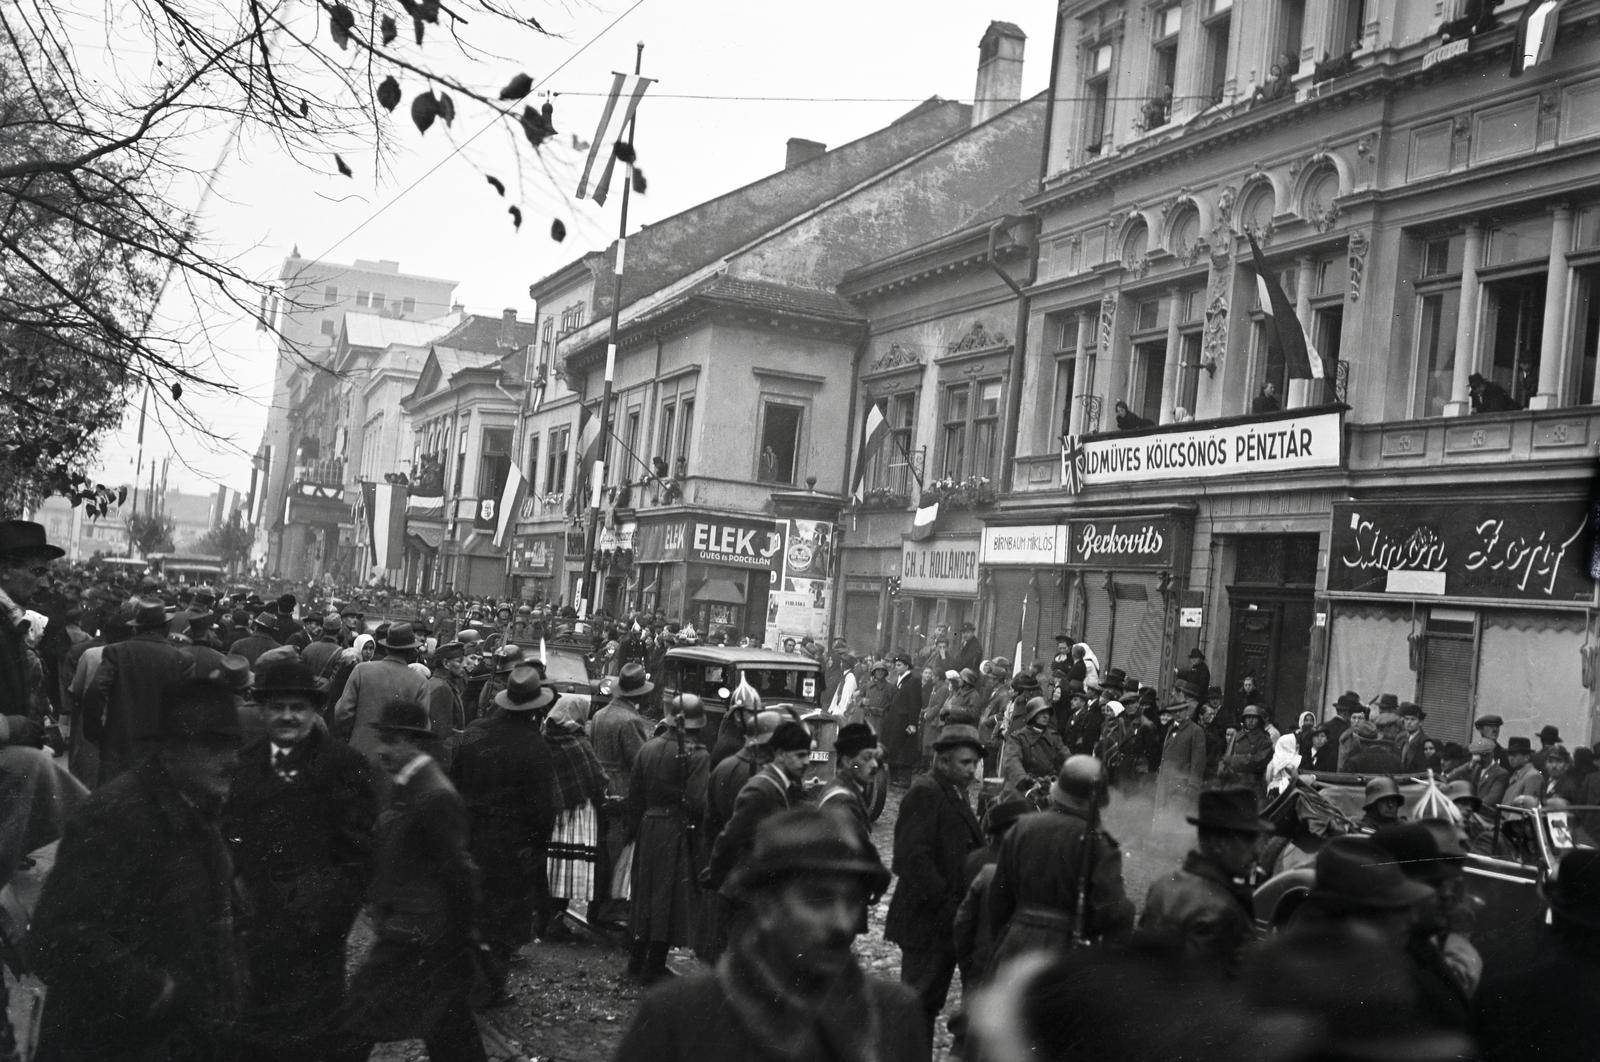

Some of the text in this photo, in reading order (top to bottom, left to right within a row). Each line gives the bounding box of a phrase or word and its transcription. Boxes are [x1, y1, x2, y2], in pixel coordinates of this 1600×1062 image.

[1147, 435, 1228, 470] KÖLCSÖNÖS
[1236, 424, 1312, 462] PÉNZTÁR
[664, 523, 687, 550] ELEK
[694, 522, 757, 556] ELEK
[728, 554, 771, 566] PORCELLÁN
